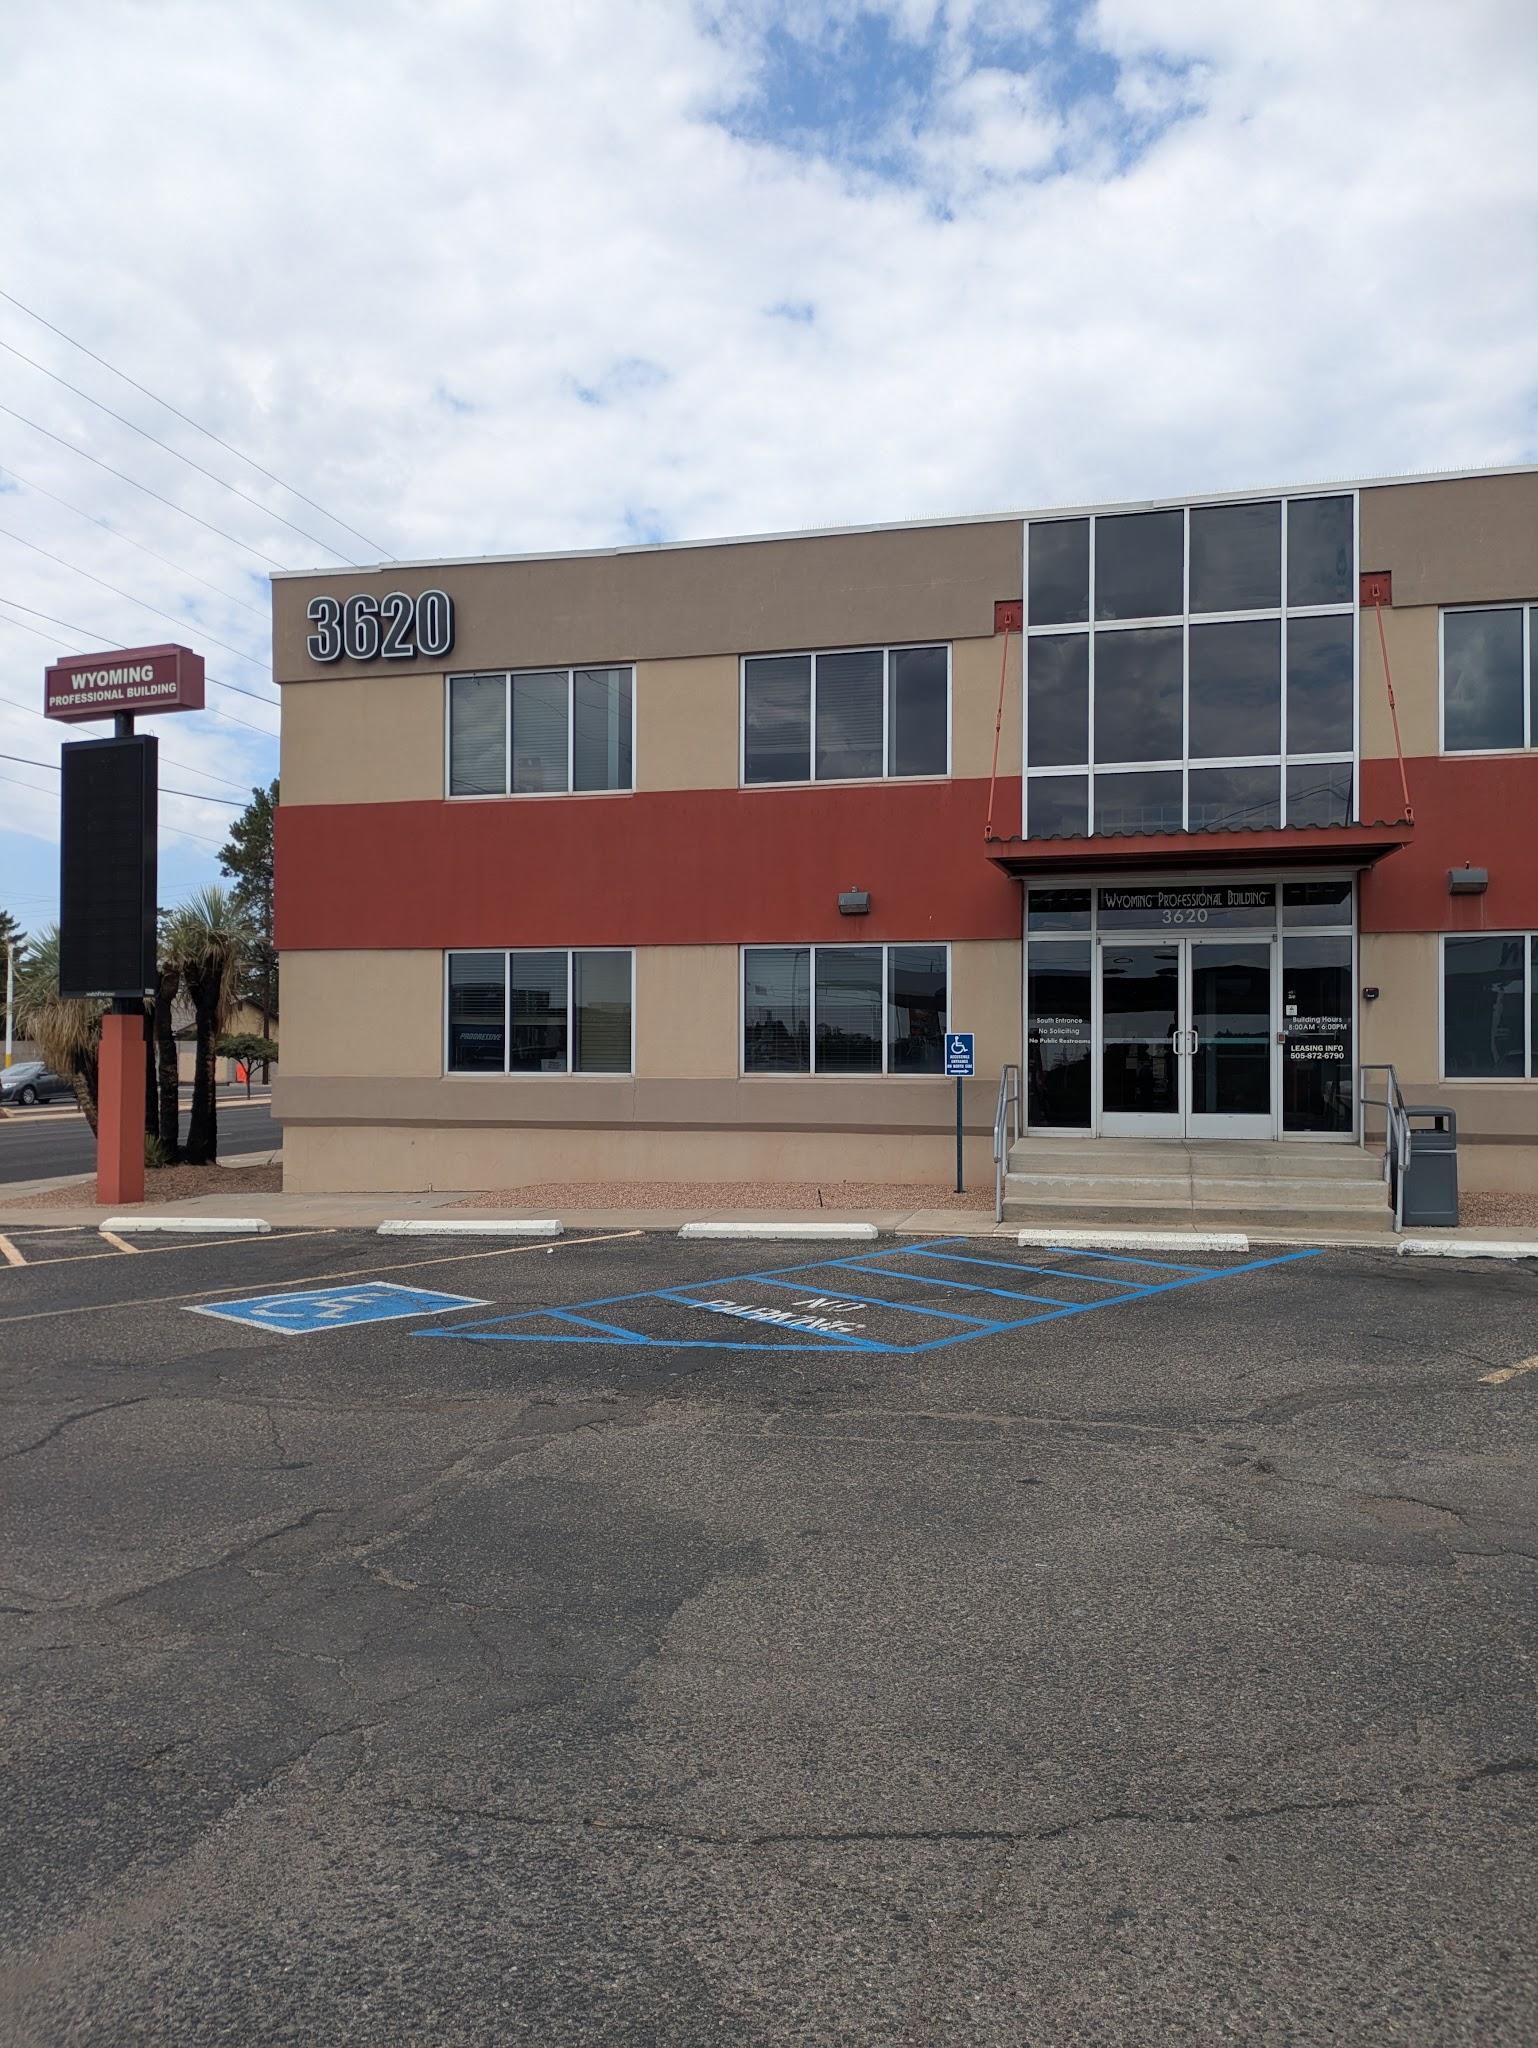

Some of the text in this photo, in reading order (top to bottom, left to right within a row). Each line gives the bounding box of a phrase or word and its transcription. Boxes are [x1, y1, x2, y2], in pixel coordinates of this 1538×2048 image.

[307, 589, 454, 663] 3620
[71, 665, 153, 689] WYOMING
[49, 682, 177, 707] PROFESSIONAL BUILDING
[1162, 909, 1208, 924] 3620
[459, 1032, 503, 1041] PROGRESSIVE
[791, 1297, 867, 1312] NO
